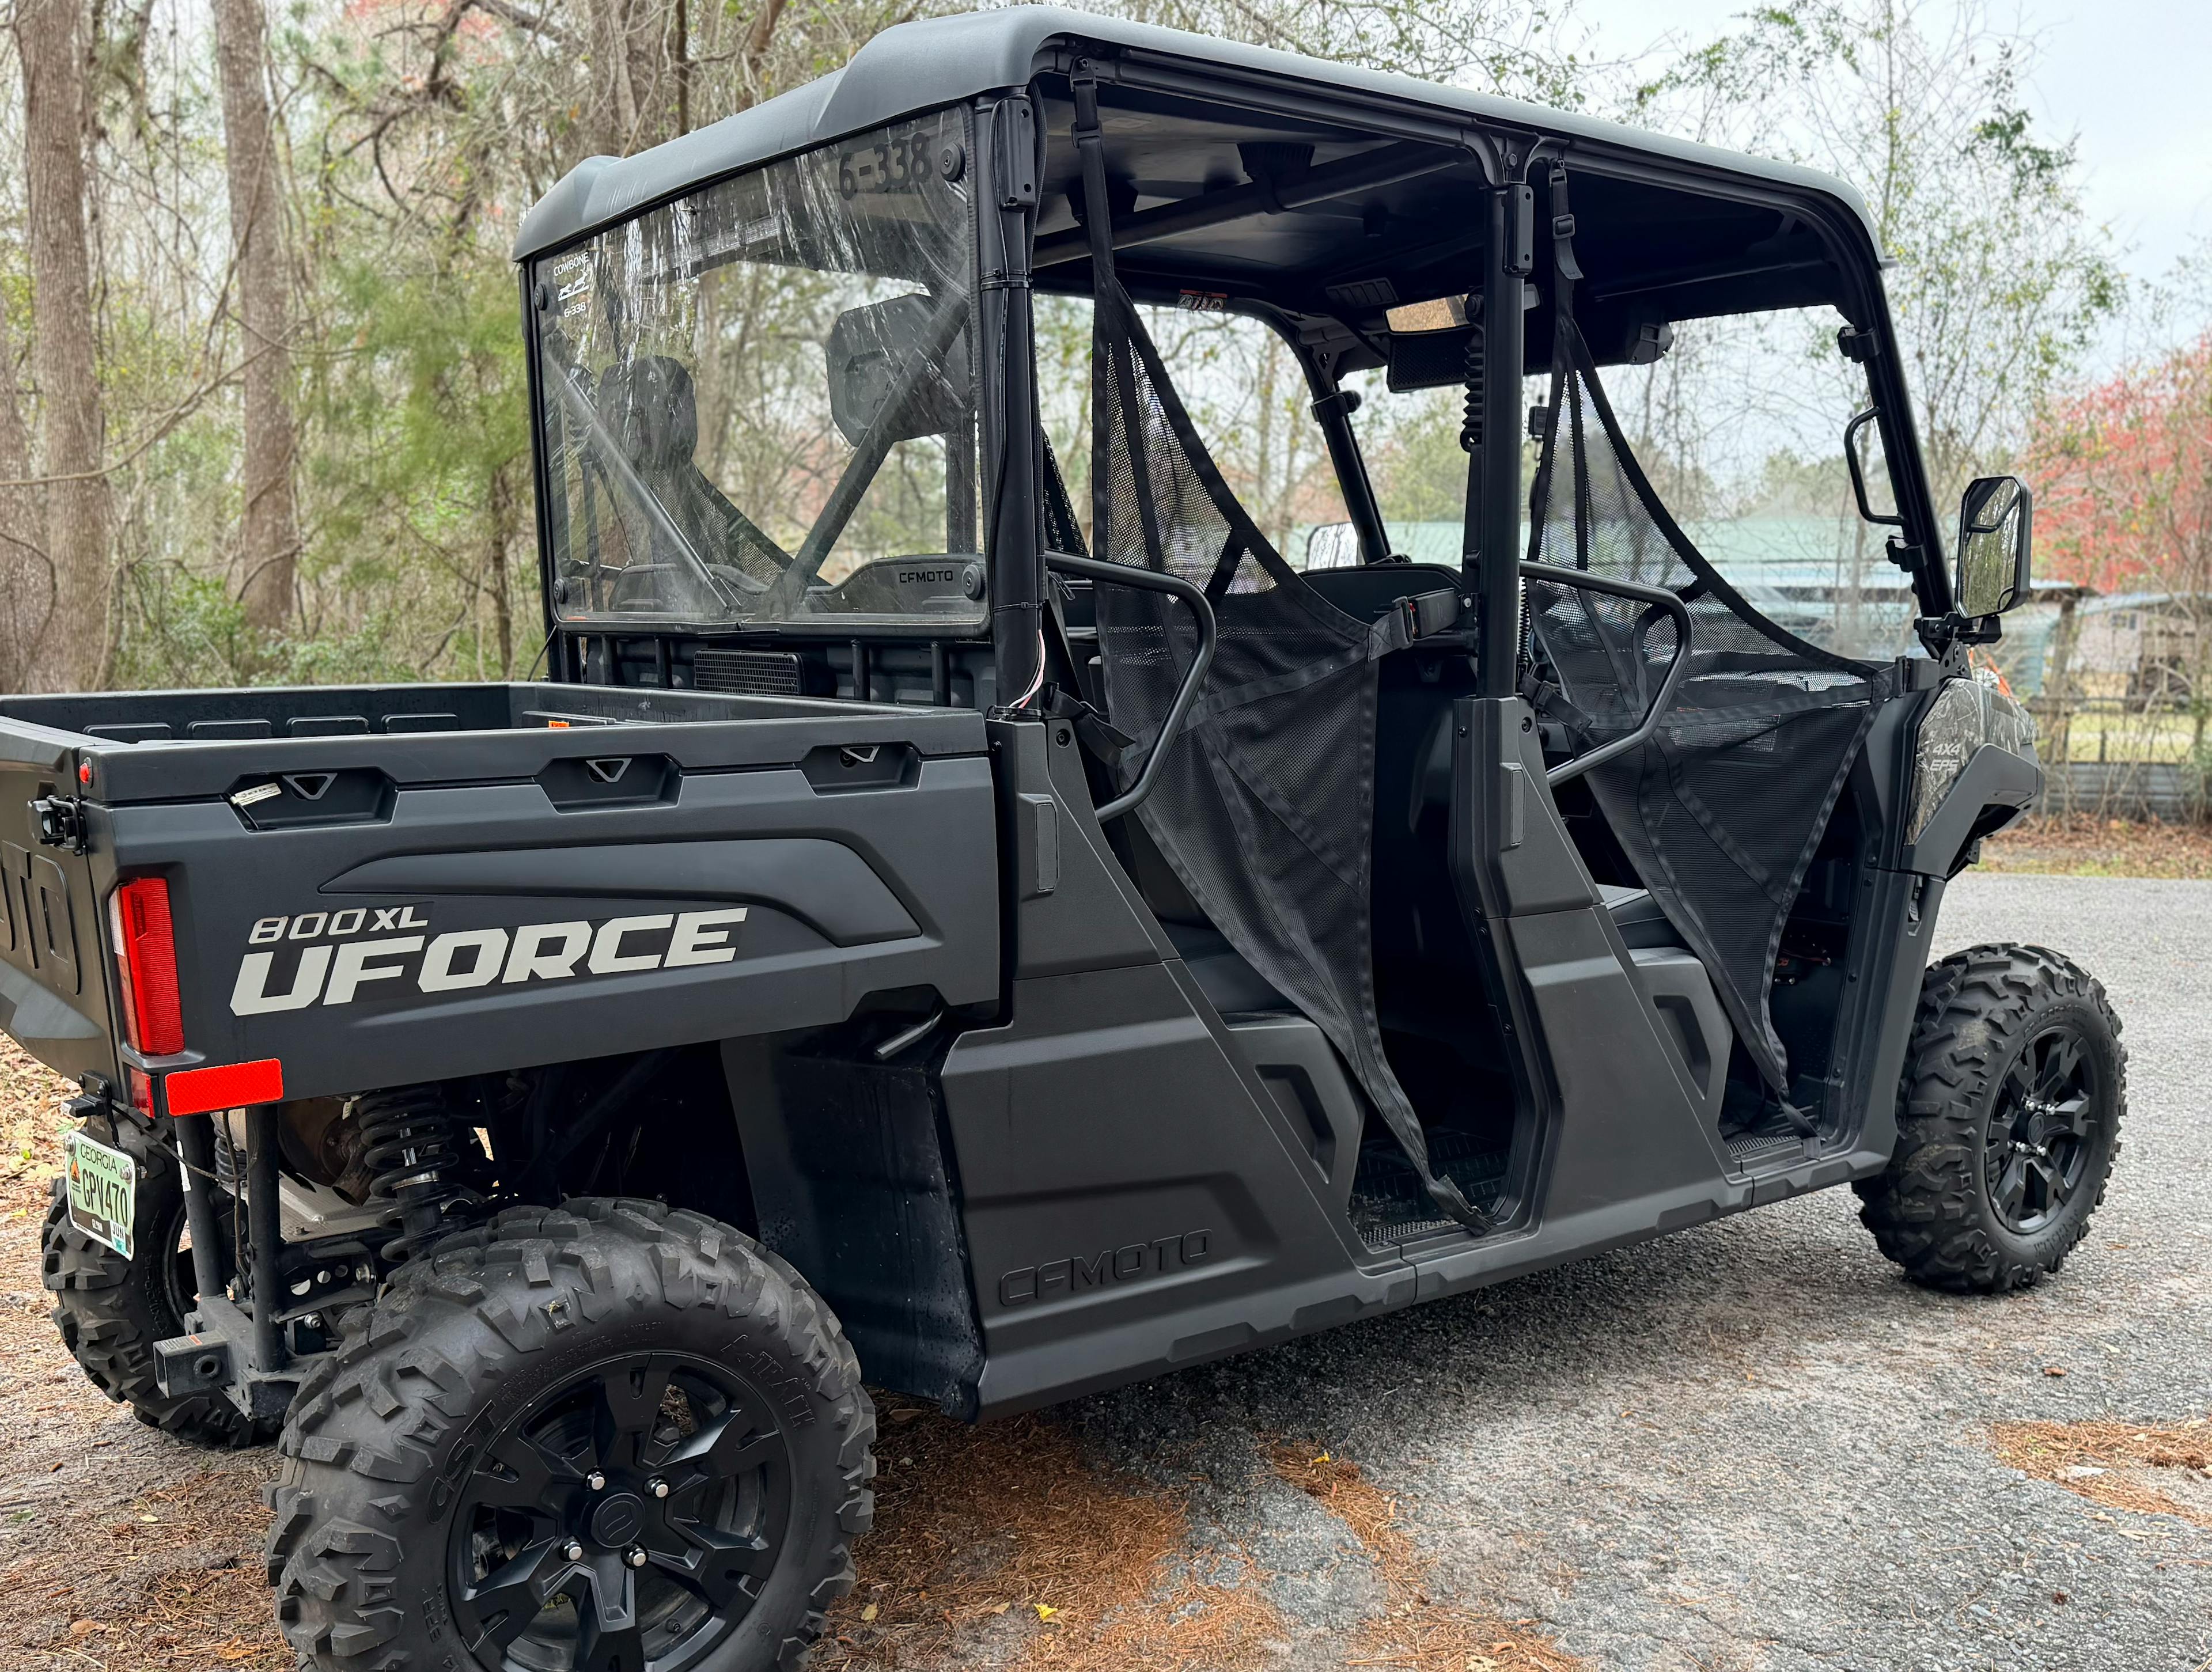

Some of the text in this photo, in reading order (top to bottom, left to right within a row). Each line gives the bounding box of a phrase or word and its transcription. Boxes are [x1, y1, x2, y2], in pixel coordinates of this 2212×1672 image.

[839, 132, 933, 201] 6-338
[554, 252, 589, 276] COWBONE
[564, 302, 586, 318] 6-338
[899, 570, 953, 583] CFMOTO
[1930, 759, 1960, 774] EPS
[230, 907, 748, 1016] UFORCE
[81, 1143, 118, 1174] GEORGIA
[82, 1168, 128, 1228] GPV470
[112, 1223, 124, 1240] JUN
[1000, 1229, 1212, 1306] CFMOTO
[426, 1398, 497, 1526] CST
